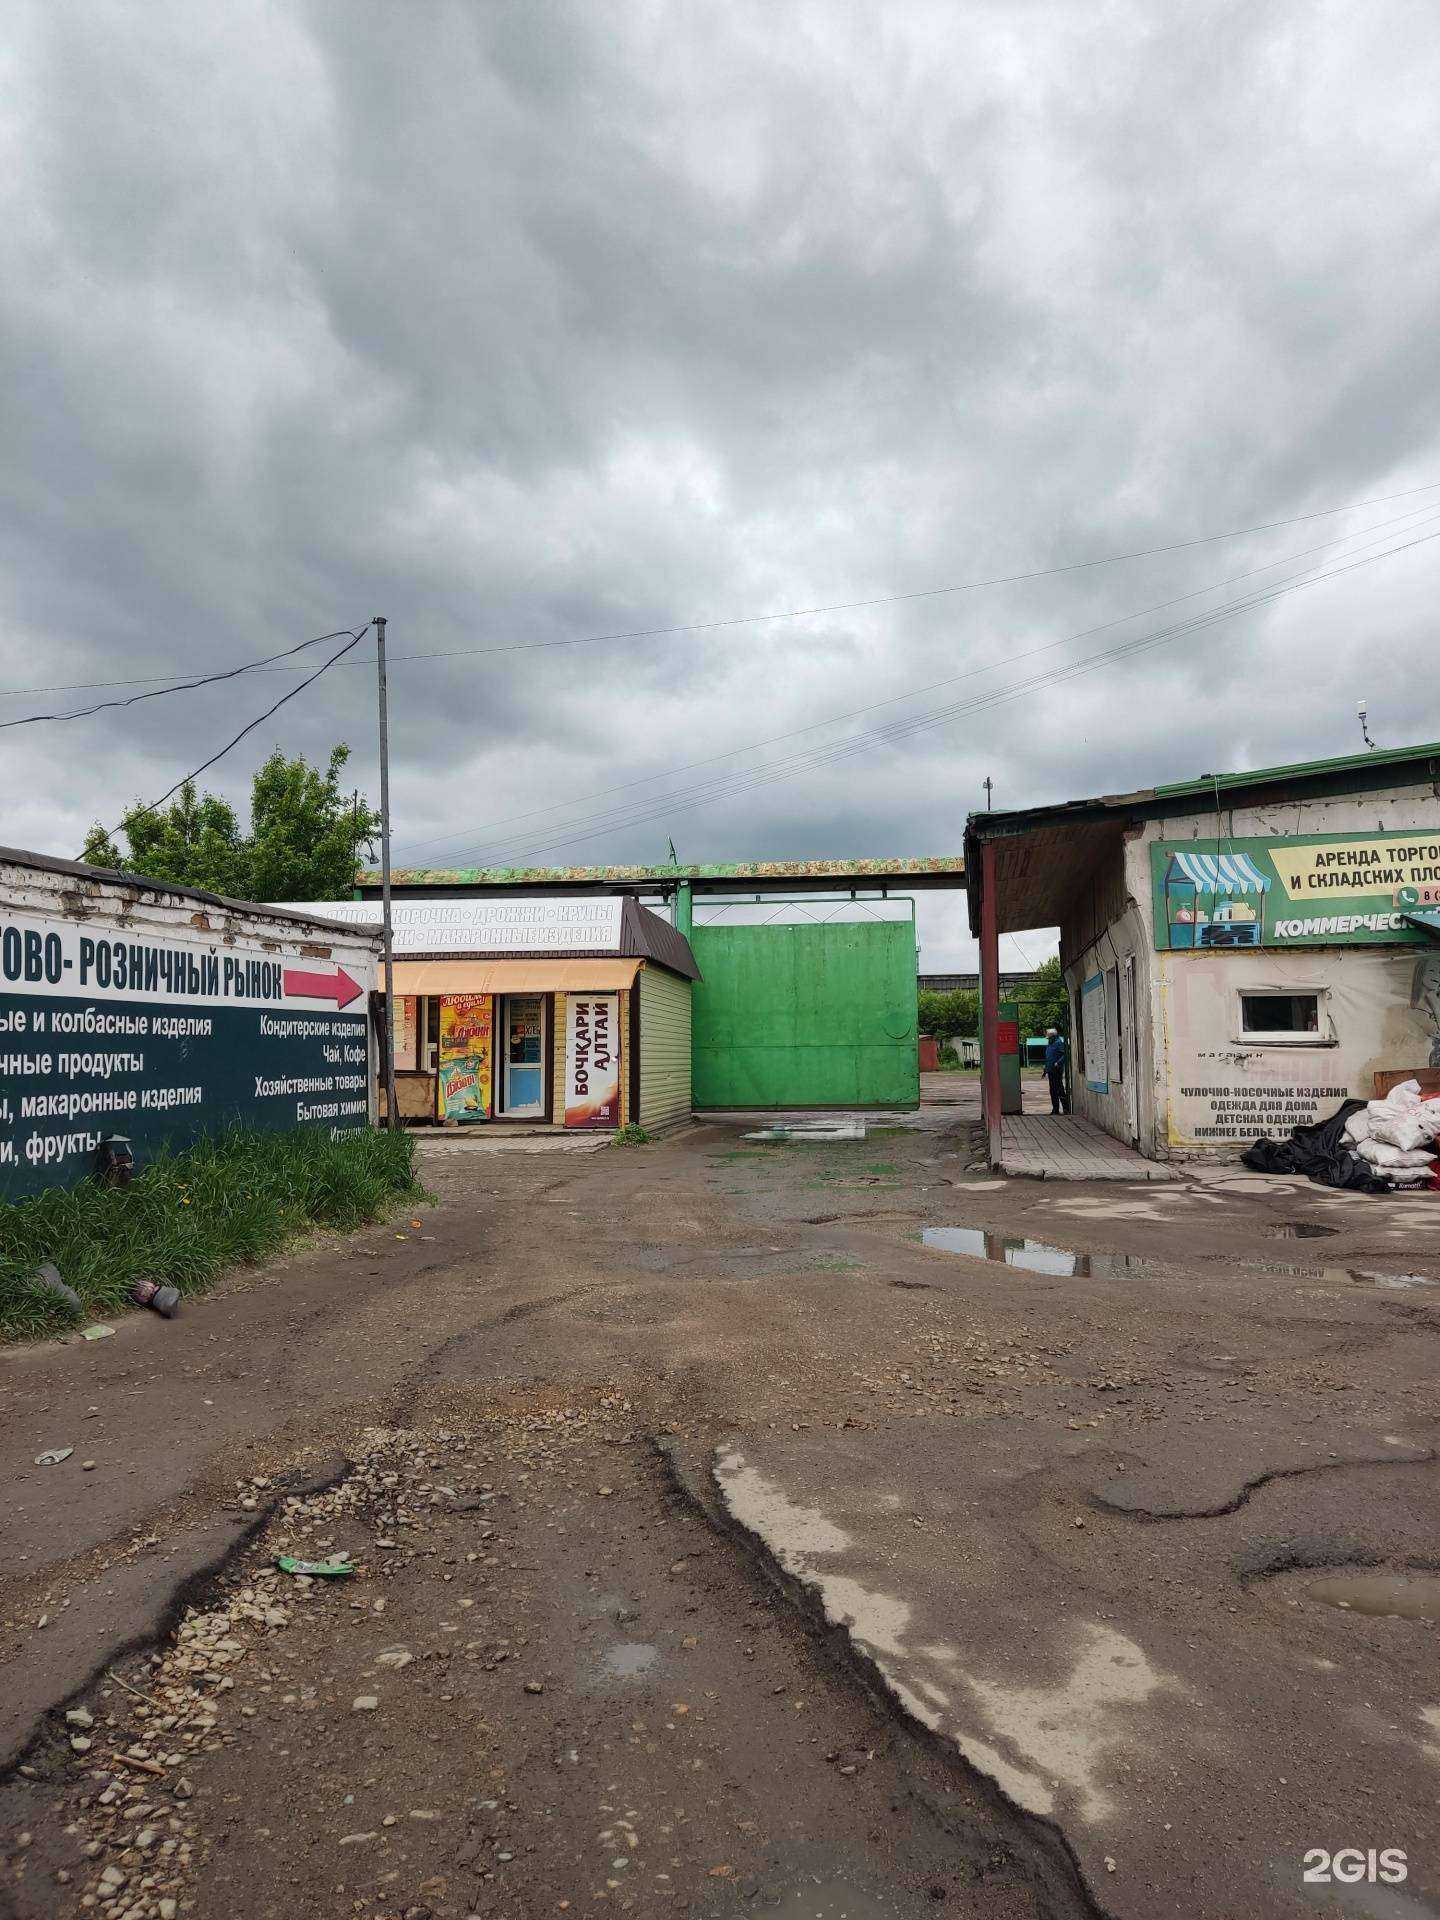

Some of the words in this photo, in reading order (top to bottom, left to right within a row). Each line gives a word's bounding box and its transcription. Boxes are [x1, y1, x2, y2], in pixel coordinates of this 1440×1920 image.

[1315, 850, 1381, 867] АРЕНДА
[1386, 844, 1440, 863] ТОРГО
[1291, 875, 1301, 889] И
[1308, 868, 1404, 889] СКЛАДСКИХ
[1424, 890, 1430, 900] 8
[538, 925, 612, 944] ИЗДЕЛИЯ
[0, 926, 73, 984] ОВО-
[80, 937, 219, 996] РОЗНИЧНЫЙ
[223, 956, 282, 1000] РЫНОК
[33, 1011, 45, 1032] и
[52, 1007, 148, 1035] колбасные
[152, 1016, 212, 1038] изделия
[260, 1014, 330, 1040] Кондитерские
[331, 1023, 366, 1039] изделия
[593, 1002, 610, 1071] АЛТАЙ
[323, 1044, 342, 1066] Чай,
[344, 1044, 366, 1066] Кофе
[575, 1003, 591, 1096] БОЧКАРИ
[58, 1052, 144, 1079] продукты
[254, 1074, 333, 1097] Хозяйственные
[334, 1074, 366, 1092] товары
[1181, 1087, 1294, 1098] ЧУЛОЧНО-НОСОЧНЫЕ
[1298, 1087, 1348, 1099] ИЗДЕЛИЯ
[21, 1089, 137, 1120] макаронные
[141, 1086, 202, 1110] изделия
[297, 1101, 338, 1121] Бытовая
[340, 1099, 367, 1115] химия
[1210, 1101, 1257, 1112] ОДЕЖДА
[1258, 1101, 1283, 1112] ДЛЯ
[1285, 1101, 1318, 1112] ДОМА
[1215, 1114, 1264, 1125] ДЕТСКАЯ
[1266, 1114, 1314, 1125] ОДЕЖДА
[25, 1131, 101, 1165] фрукты
